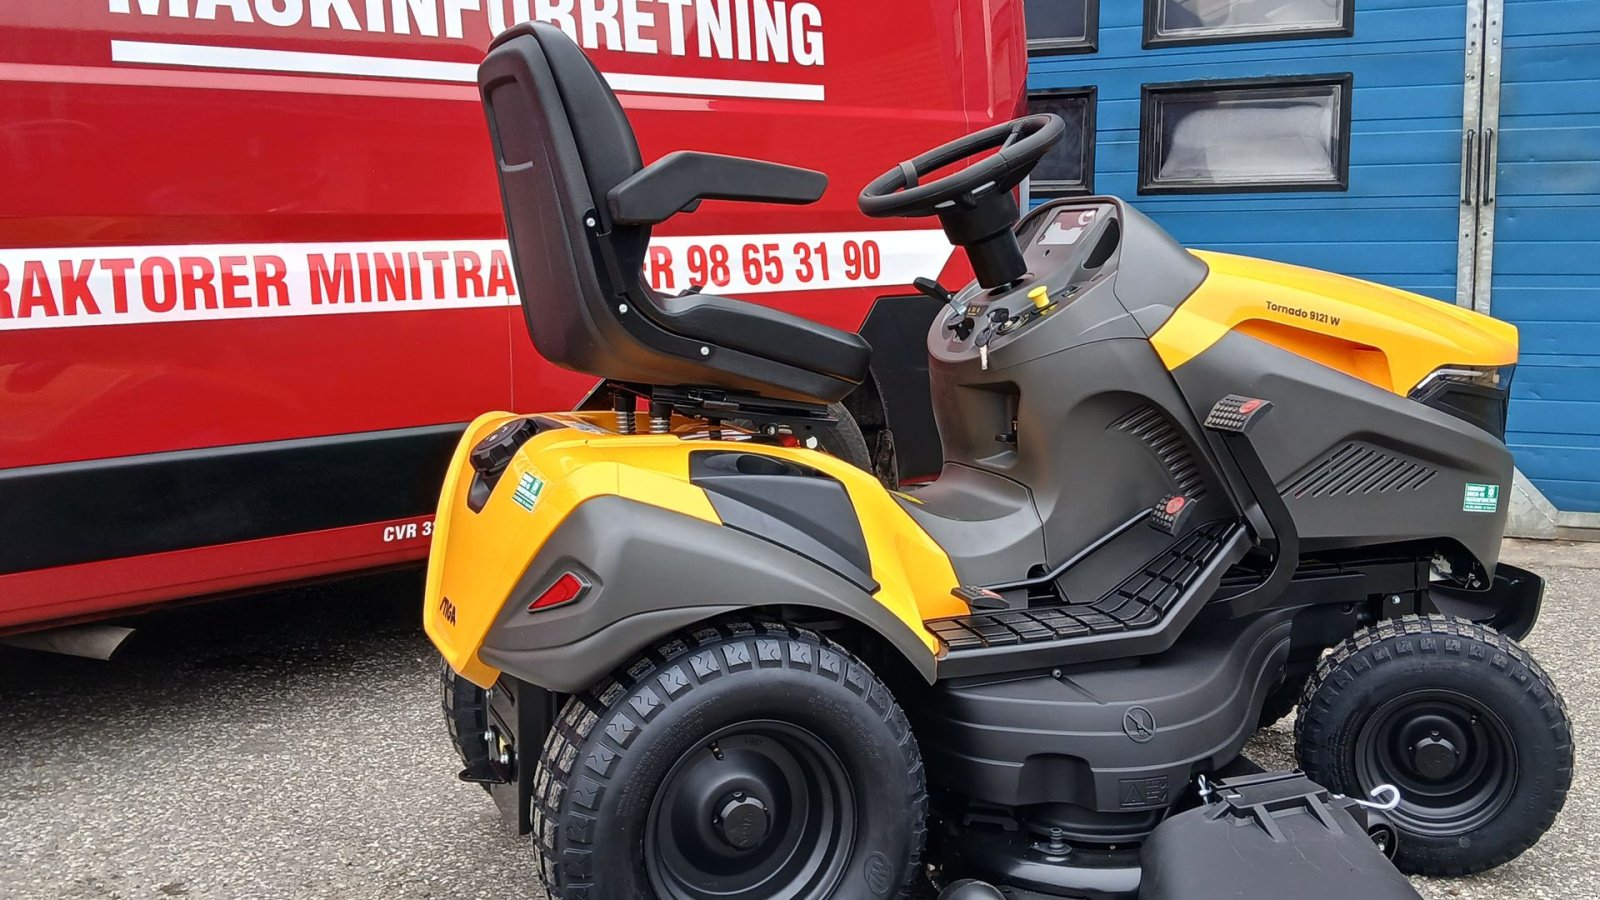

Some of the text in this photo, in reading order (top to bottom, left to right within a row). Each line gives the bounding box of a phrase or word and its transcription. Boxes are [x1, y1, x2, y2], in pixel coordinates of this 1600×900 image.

[107, 0, 825, 66] NFRRETNING
[687, 244, 730, 288] 98
[742, 243, 783, 286] 65
[793, 241, 829, 283] 31
[842, 239, 881, 280] 90
[1266, 300, 1341, 326] Tornado 9121 W
[383, 521, 435, 542] CVR 3
